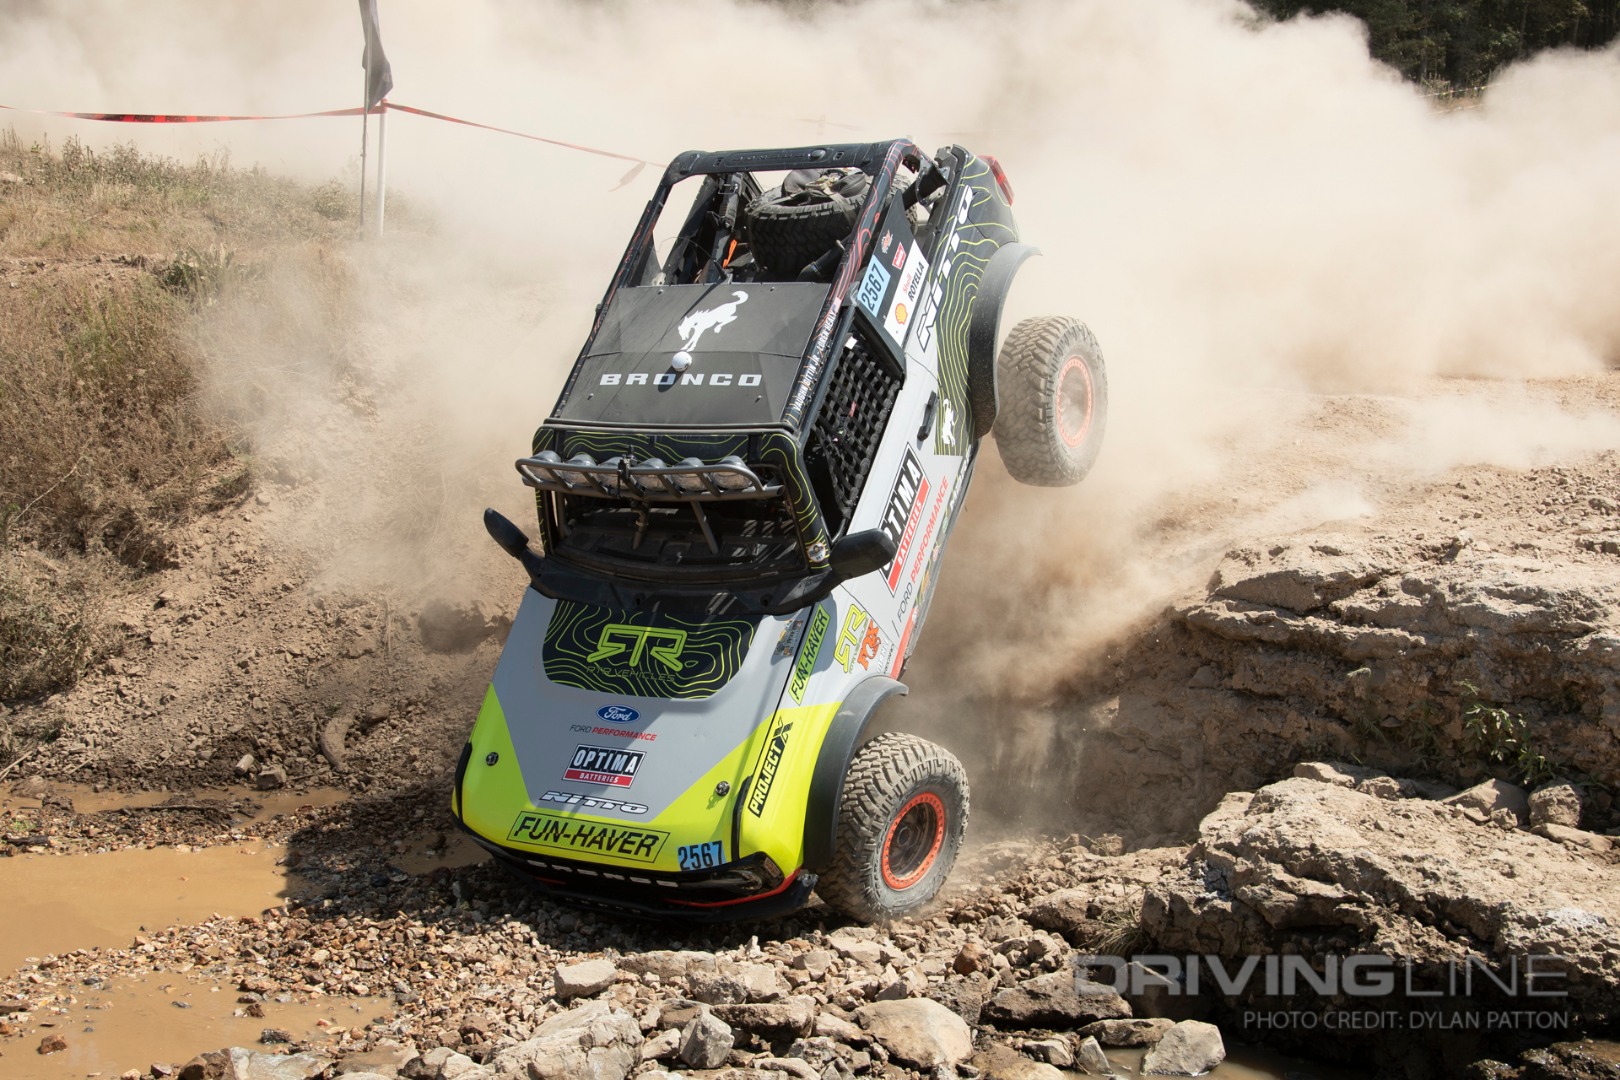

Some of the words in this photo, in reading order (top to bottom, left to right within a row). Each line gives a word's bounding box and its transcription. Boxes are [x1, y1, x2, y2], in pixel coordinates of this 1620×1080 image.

[861, 263, 885, 312] 2567
[902, 273, 913, 295] Shell
[907, 261, 925, 302] ROTELLA
[599, 373, 763, 386] BRONCO
[792, 385, 809, 412] VAUGHN
[883, 459, 922, 571] TIMA
[897, 499, 922, 567] BATTERIES
[897, 581, 914, 624] FORD
[910, 475, 949, 585] PERFORMANCE
[586, 623, 689, 672] RTR
[791, 609, 828, 700] FUN-HAVER
[834, 603, 867, 673] RTR
[857, 619, 881, 671] FOX
[586, 665, 612, 675] RTR
[615, 668, 676, 682] VEHICLES
[569, 724, 592, 733] FORD
[592, 726, 657, 742] PERFORMANCE
[603, 705, 633, 721] Ford
[573, 749, 639, 775] OPTIMA
[579, 773, 619, 784] BATTERIES
[749, 739, 783, 816] PROJECT
[539, 791, 650, 815] NITTO
[513, 816, 660, 858] FUN-HAVER
[677, 840, 724, 871] 2567
